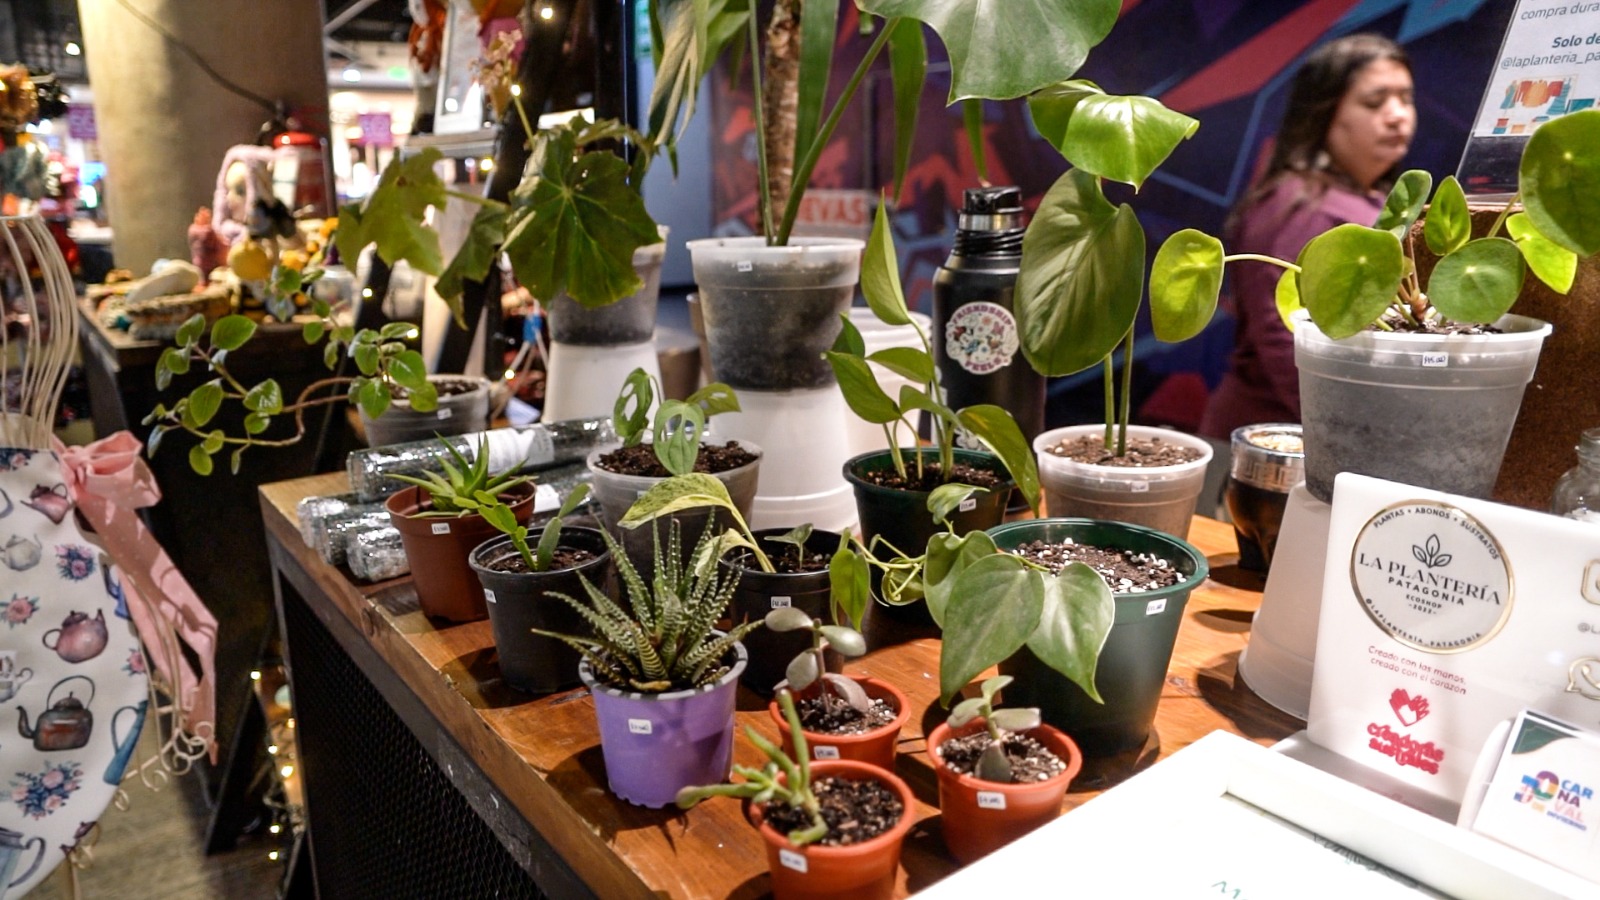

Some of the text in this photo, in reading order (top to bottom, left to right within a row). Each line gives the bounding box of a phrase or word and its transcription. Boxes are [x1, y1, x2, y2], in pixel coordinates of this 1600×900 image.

[1521, 2, 1600, 20] compra dura
[1551, 35, 1583, 48] Solo
[952, 304, 1013, 326] FRIENDSHIP
[965, 356, 1002, 372] FEELS
[1373, 507, 1500, 560] PLANTAS ABONOS SUSTRATOS
[1359, 553, 1500, 605] LA PLANTERÍA
[1388, 576, 1465, 606] PATAGONIA
[1406, 594, 1442, 609] ECOSHOP
[1368, 645, 1399, 661] Creado
[1400, 657, 1417, 668] con
[1419, 662, 1432, 673] las
[1370, 657, 1400, 673] creado
[1401, 668, 1418, 679] con
[1420, 673, 1428, 682] el
[1557, 789, 1580, 808] NA
[1561, 779, 1594, 799] CAR
